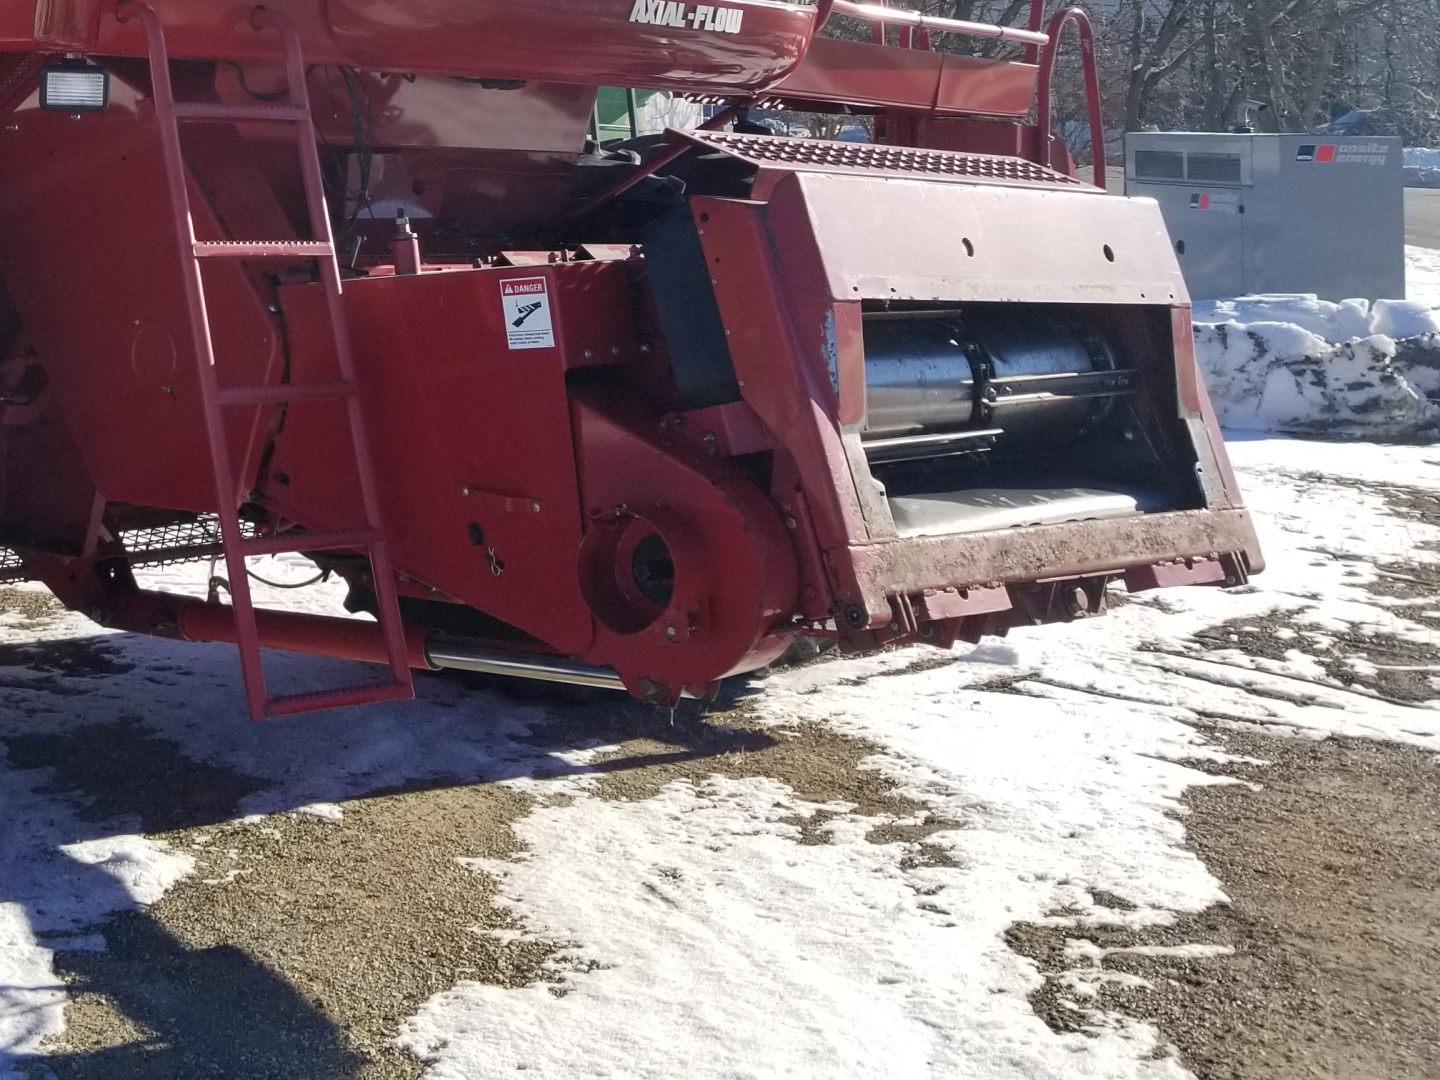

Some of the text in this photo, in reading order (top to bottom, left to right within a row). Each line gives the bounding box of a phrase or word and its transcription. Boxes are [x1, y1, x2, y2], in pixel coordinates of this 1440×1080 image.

[1339, 143, 1389, 153] onsite
[1336, 154, 1386, 166] energy
[514, 283, 543, 294] DANGER
